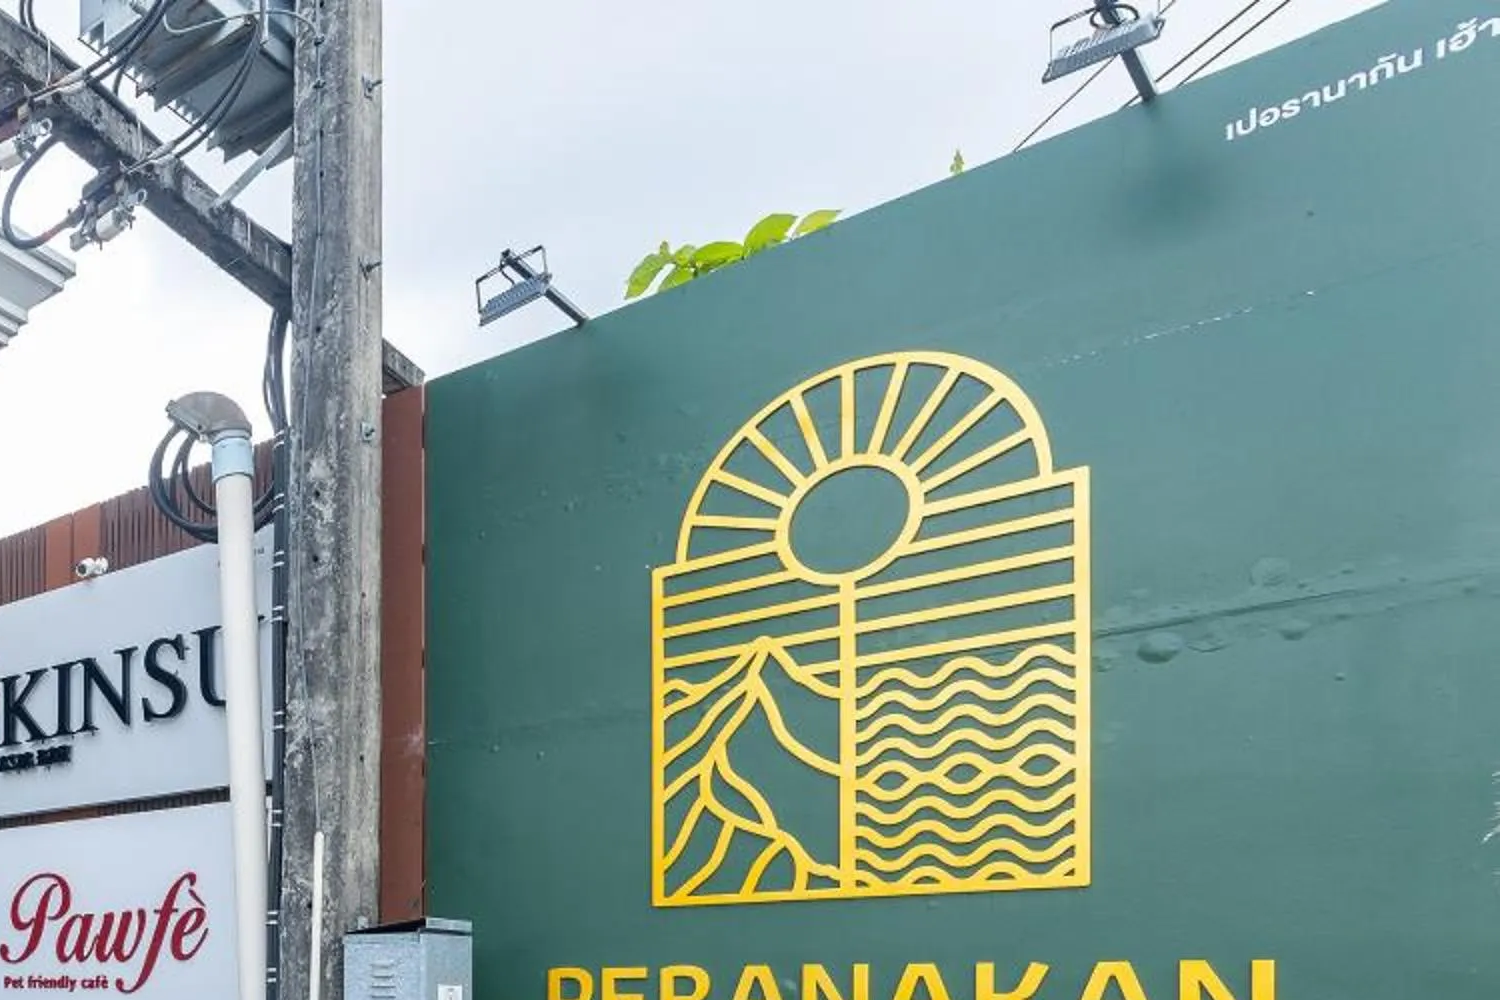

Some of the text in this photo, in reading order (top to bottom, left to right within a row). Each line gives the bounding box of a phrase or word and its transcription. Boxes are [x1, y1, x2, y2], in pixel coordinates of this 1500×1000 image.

[1225, 47, 1423, 141] เปอรานากัน
[4, 976, 24, 989] Pet
[27, 976, 76, 992] friendly
